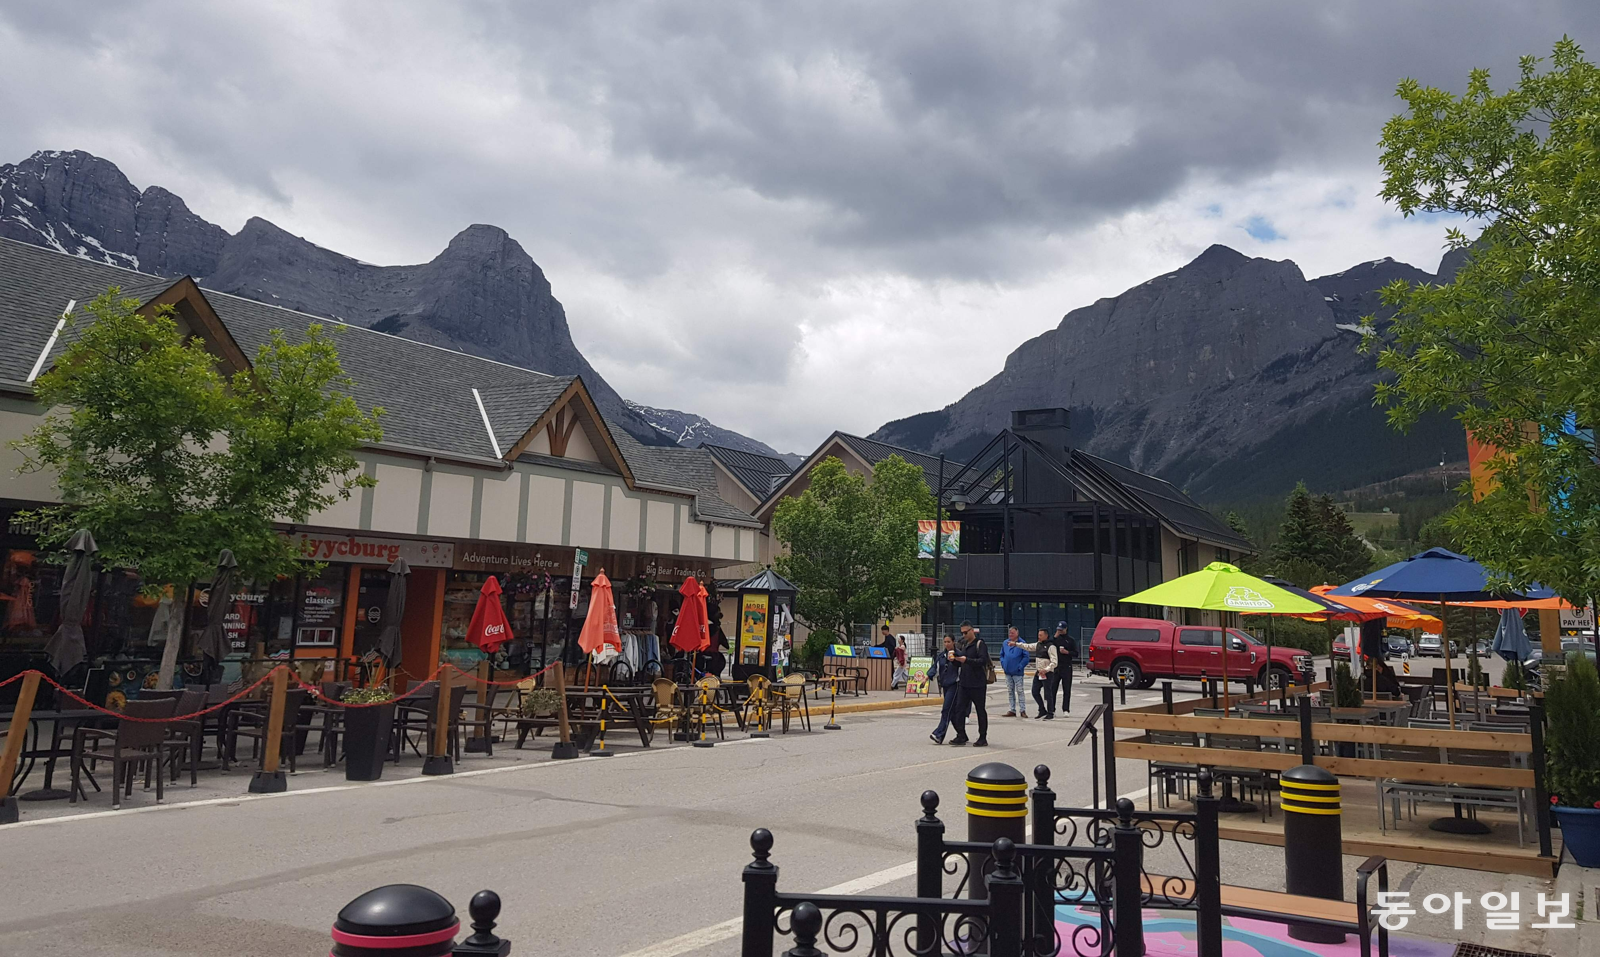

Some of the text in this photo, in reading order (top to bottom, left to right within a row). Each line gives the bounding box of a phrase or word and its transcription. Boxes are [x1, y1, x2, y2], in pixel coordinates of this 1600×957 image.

[462, 552, 553, 567] Adventure Lives Here
[646, 565, 707, 577] Big Bear Trading Co.
[230, 593, 265, 604] ycburg
[305, 596, 335, 604] classics
